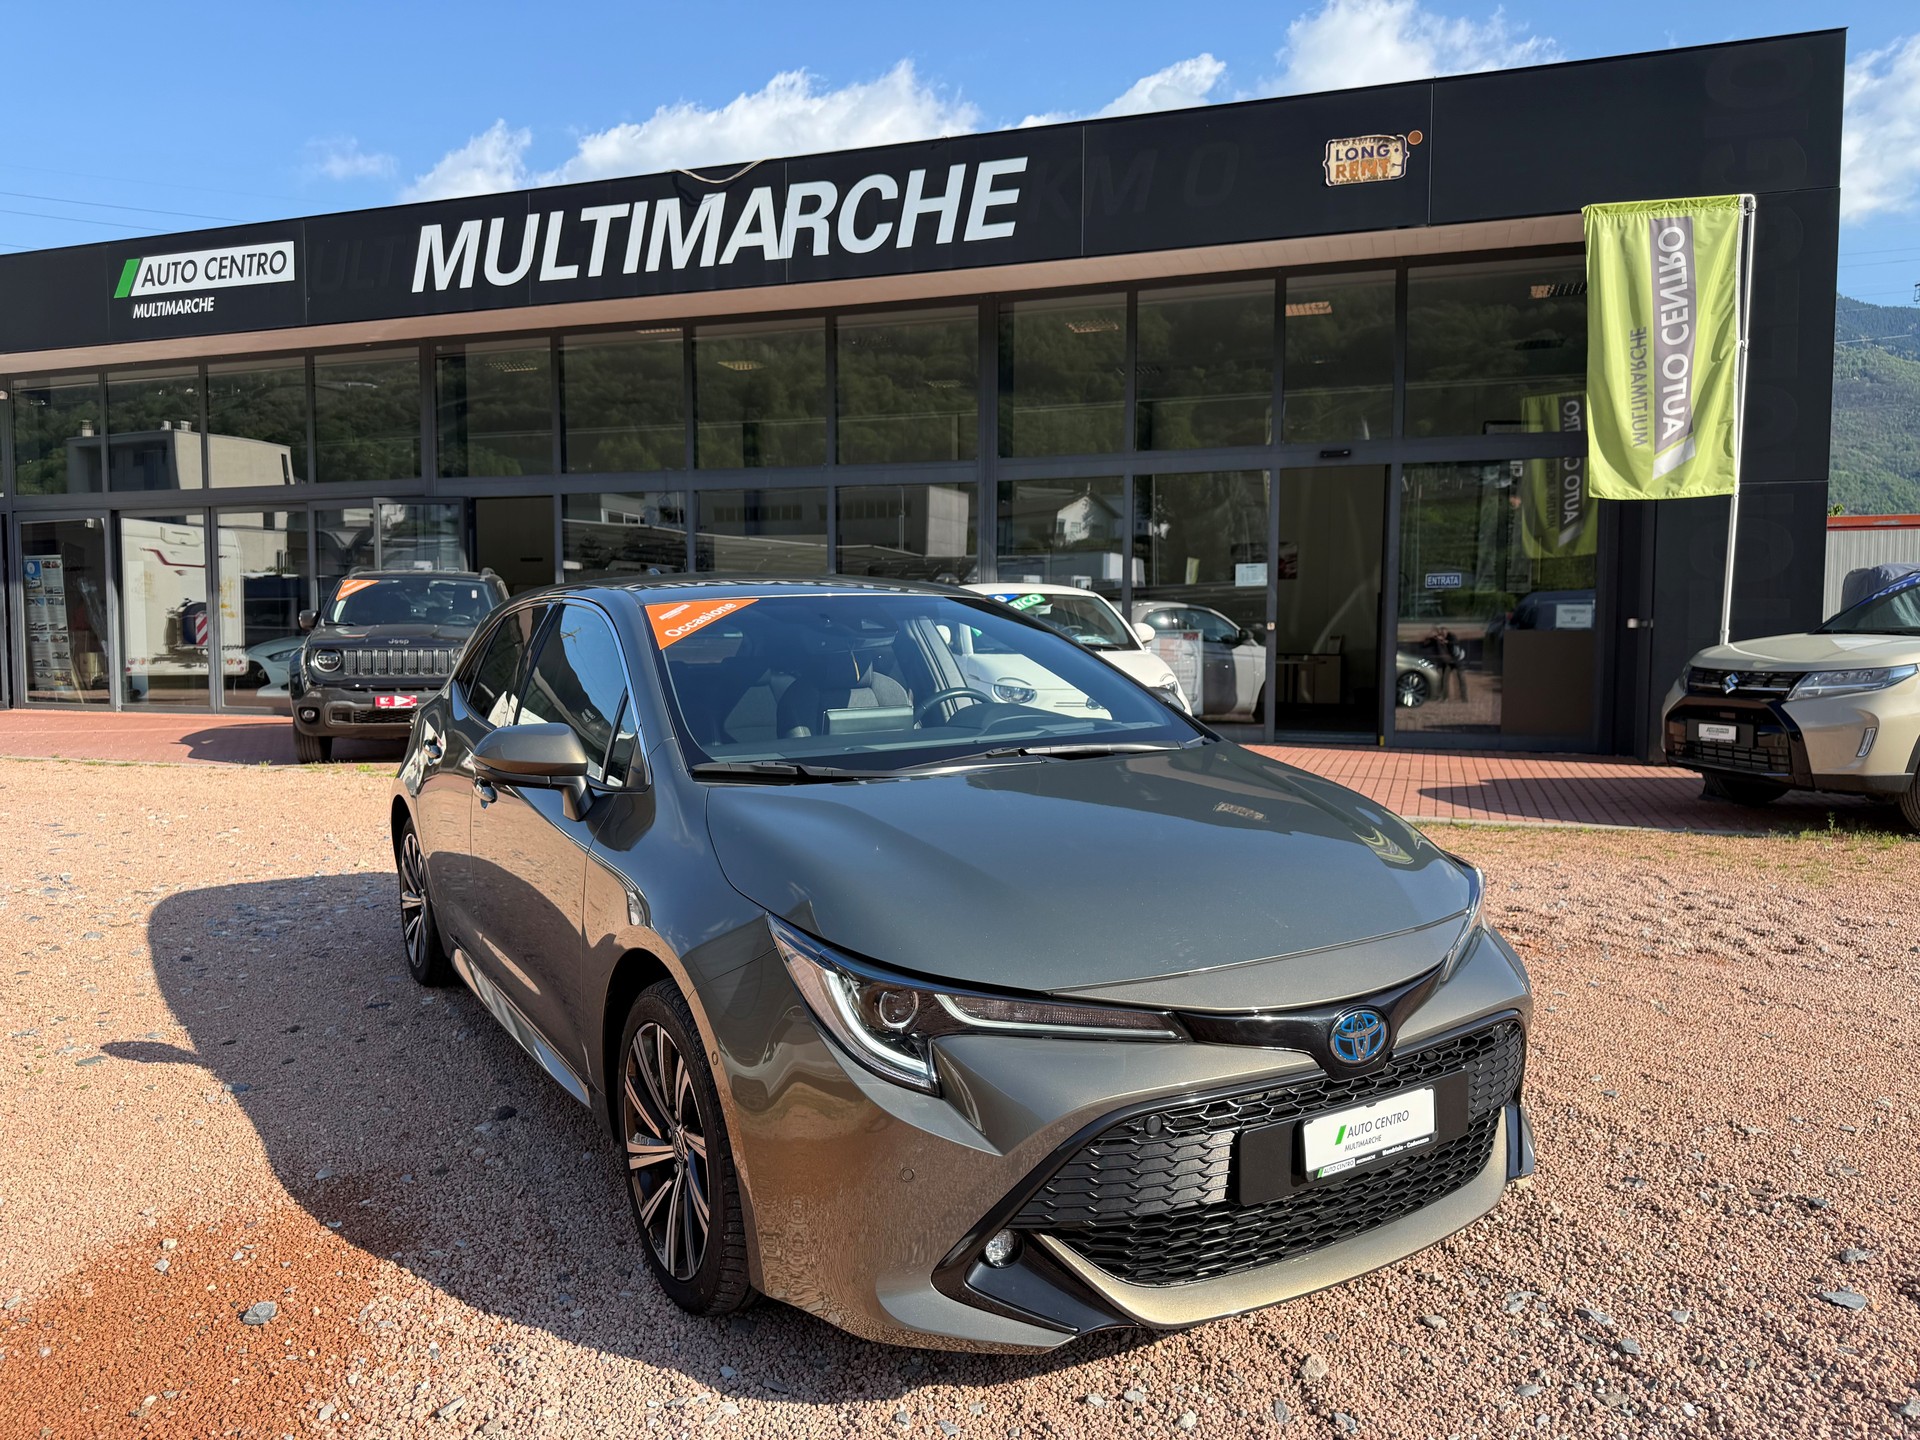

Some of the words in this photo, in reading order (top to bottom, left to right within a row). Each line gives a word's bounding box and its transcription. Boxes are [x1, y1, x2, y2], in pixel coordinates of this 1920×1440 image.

[1336, 144, 1390, 161] LONG
[1335, 158, 1391, 179] RENT
[411, 156, 1028, 293] MULTIMARCHE
[141, 259, 198, 288] AUTO
[204, 250, 287, 281] CENTRO
[132, 297, 215, 319] MULTIMARCHE
[1427, 575, 1459, 586] ENTRATA
[664, 602, 737, 637] Occasione
[1346, 1121, 1373, 1138] AUTO
[1375, 1110, 1410, 1130] CENTRO
[1344, 1135, 1382, 1152] MULTIMARCHE
[1323, 1165, 1336, 1174] AUTO
[1336, 1160, 1354, 1171] CENTRO
